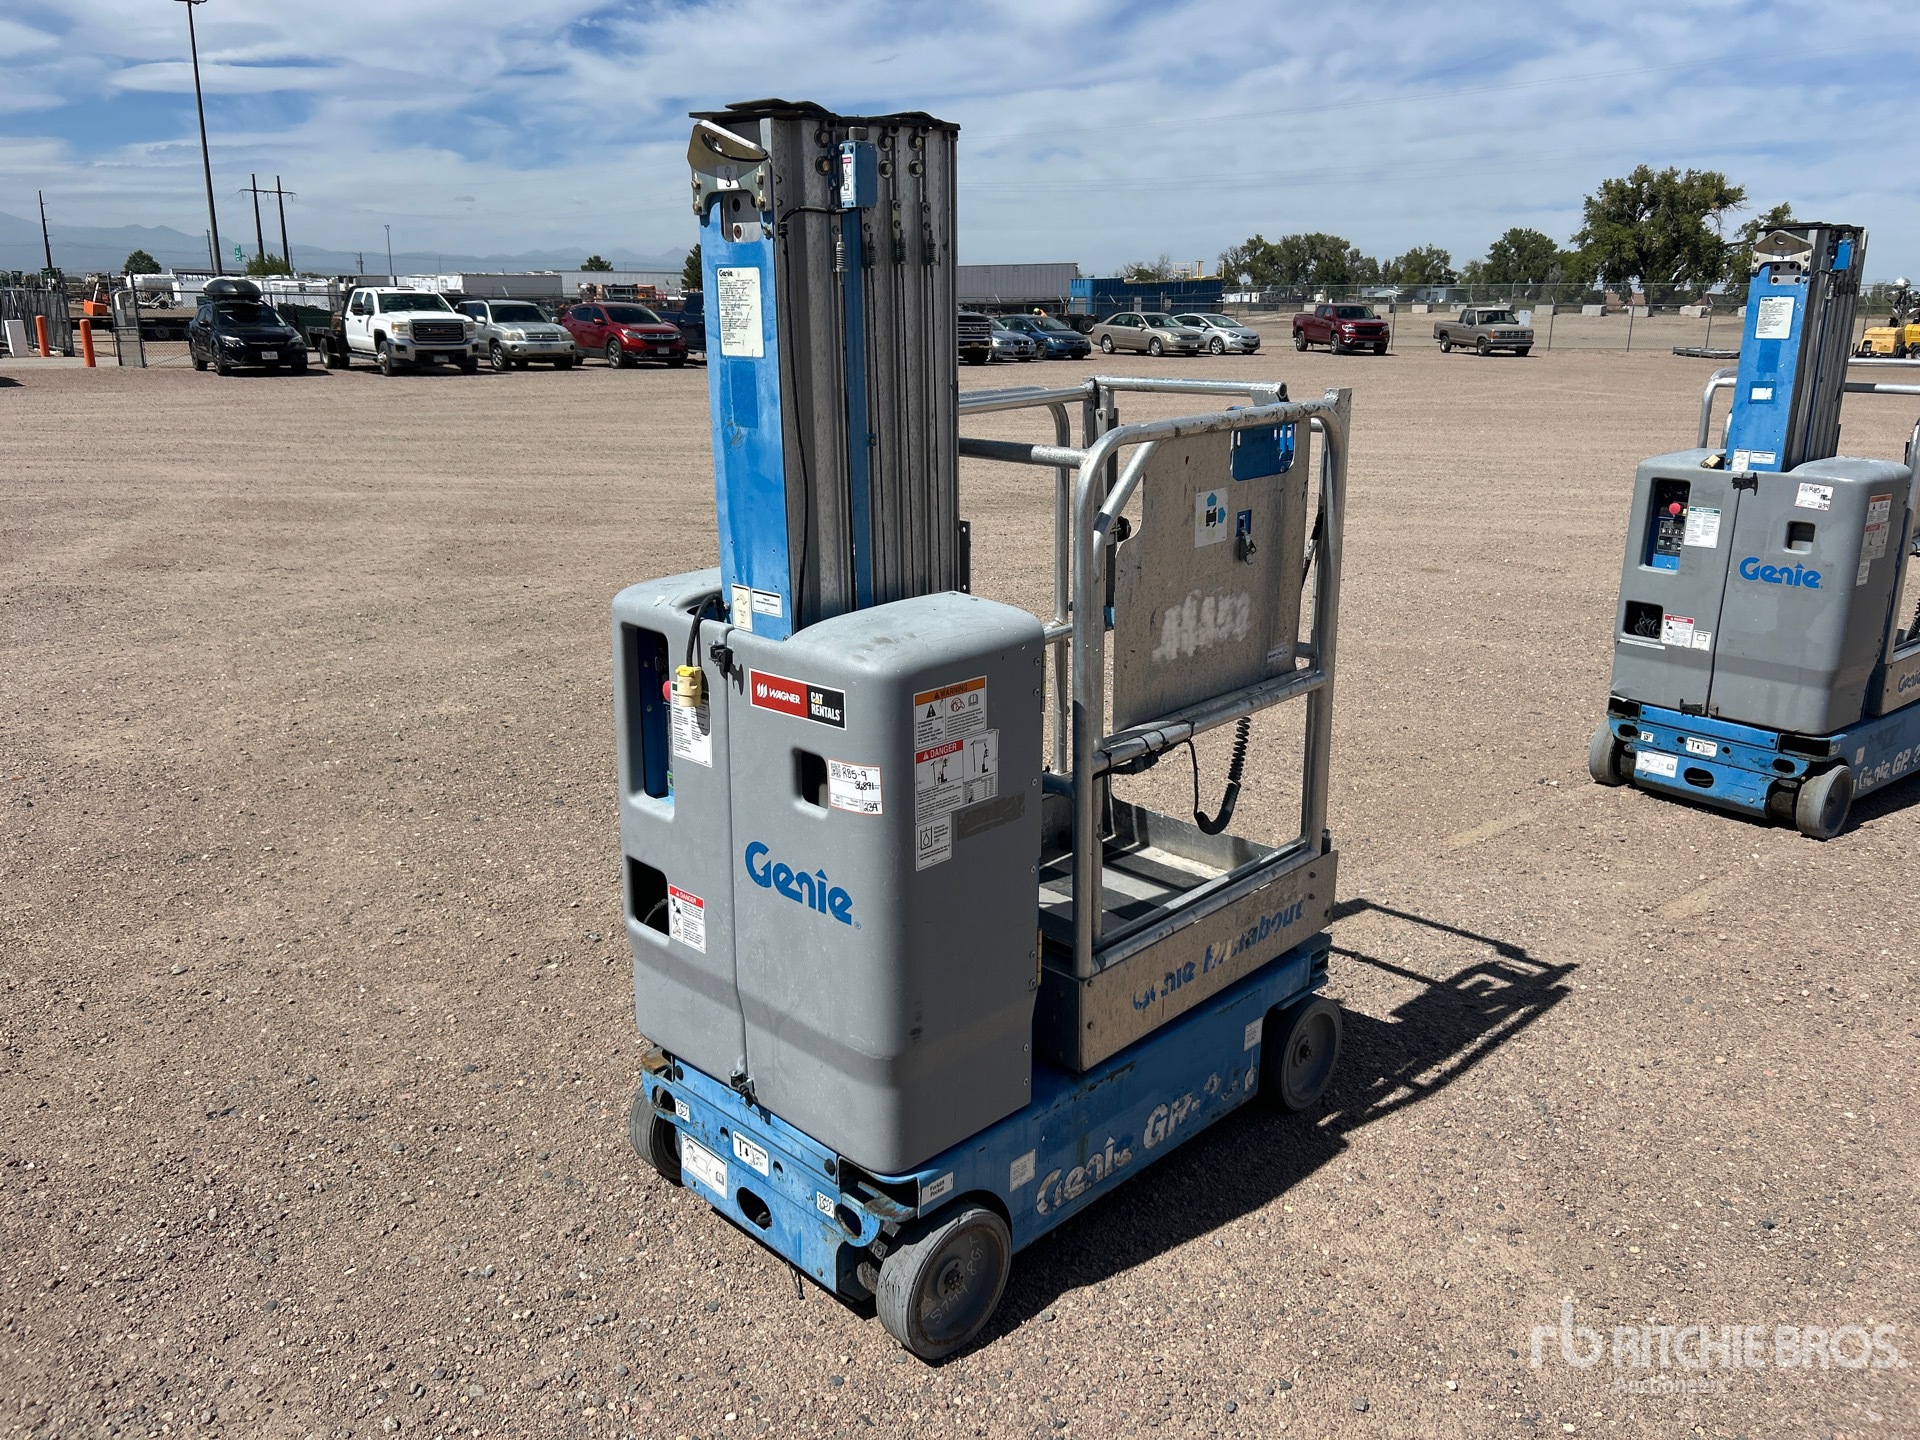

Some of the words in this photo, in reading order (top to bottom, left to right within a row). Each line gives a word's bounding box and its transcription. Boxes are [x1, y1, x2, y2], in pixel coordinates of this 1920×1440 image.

[1739, 556, 1822, 589] Genie
[769, 688, 800, 705] WAGNER
[811, 692, 823, 704] CAT
[940, 684, 968, 698] WARNING
[811, 704, 840, 721] RENTALS
[931, 743, 957, 758] DANGER
[745, 841, 853, 926] Genie
[680, 891, 697, 904] DANGER
[930, 1186, 945, 1197] Pocket
